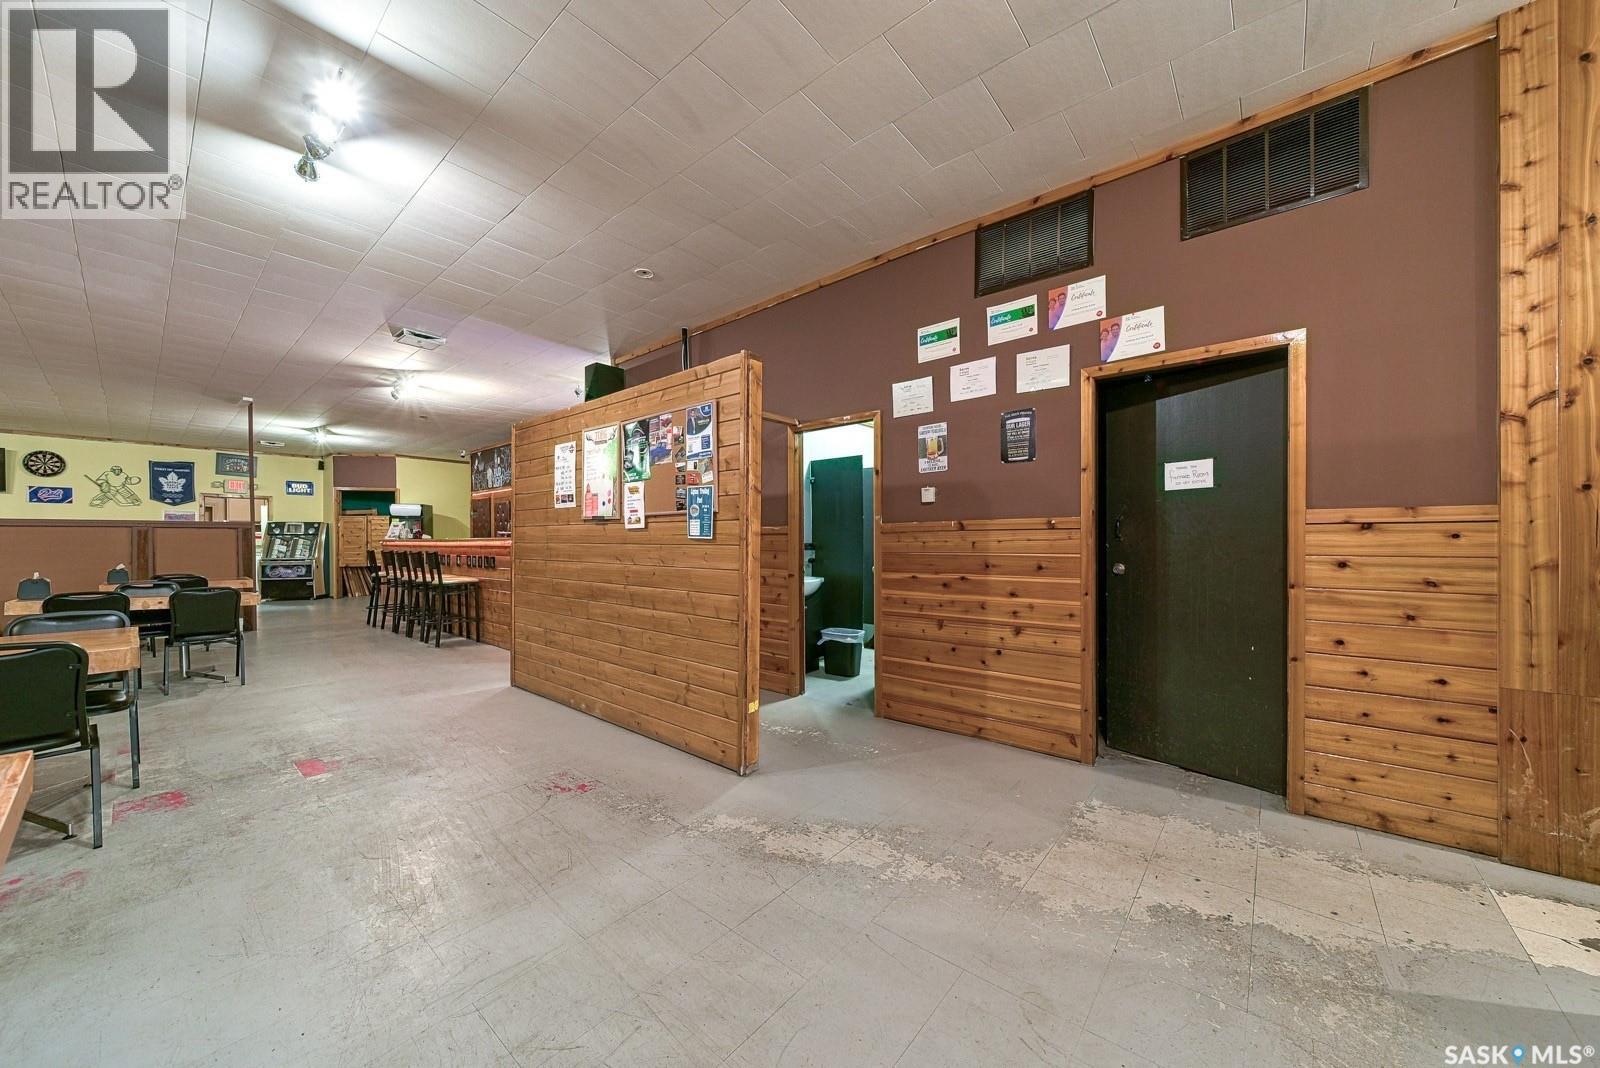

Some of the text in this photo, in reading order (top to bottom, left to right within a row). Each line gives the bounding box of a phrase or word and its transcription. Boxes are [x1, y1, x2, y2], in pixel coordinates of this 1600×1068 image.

[1070, 288, 1096, 302] Certificate
[1126, 319, 1153, 333] Certificate
[1016, 421, 1030, 429] LAGER
[1192, 470, 1209, 478] Room
